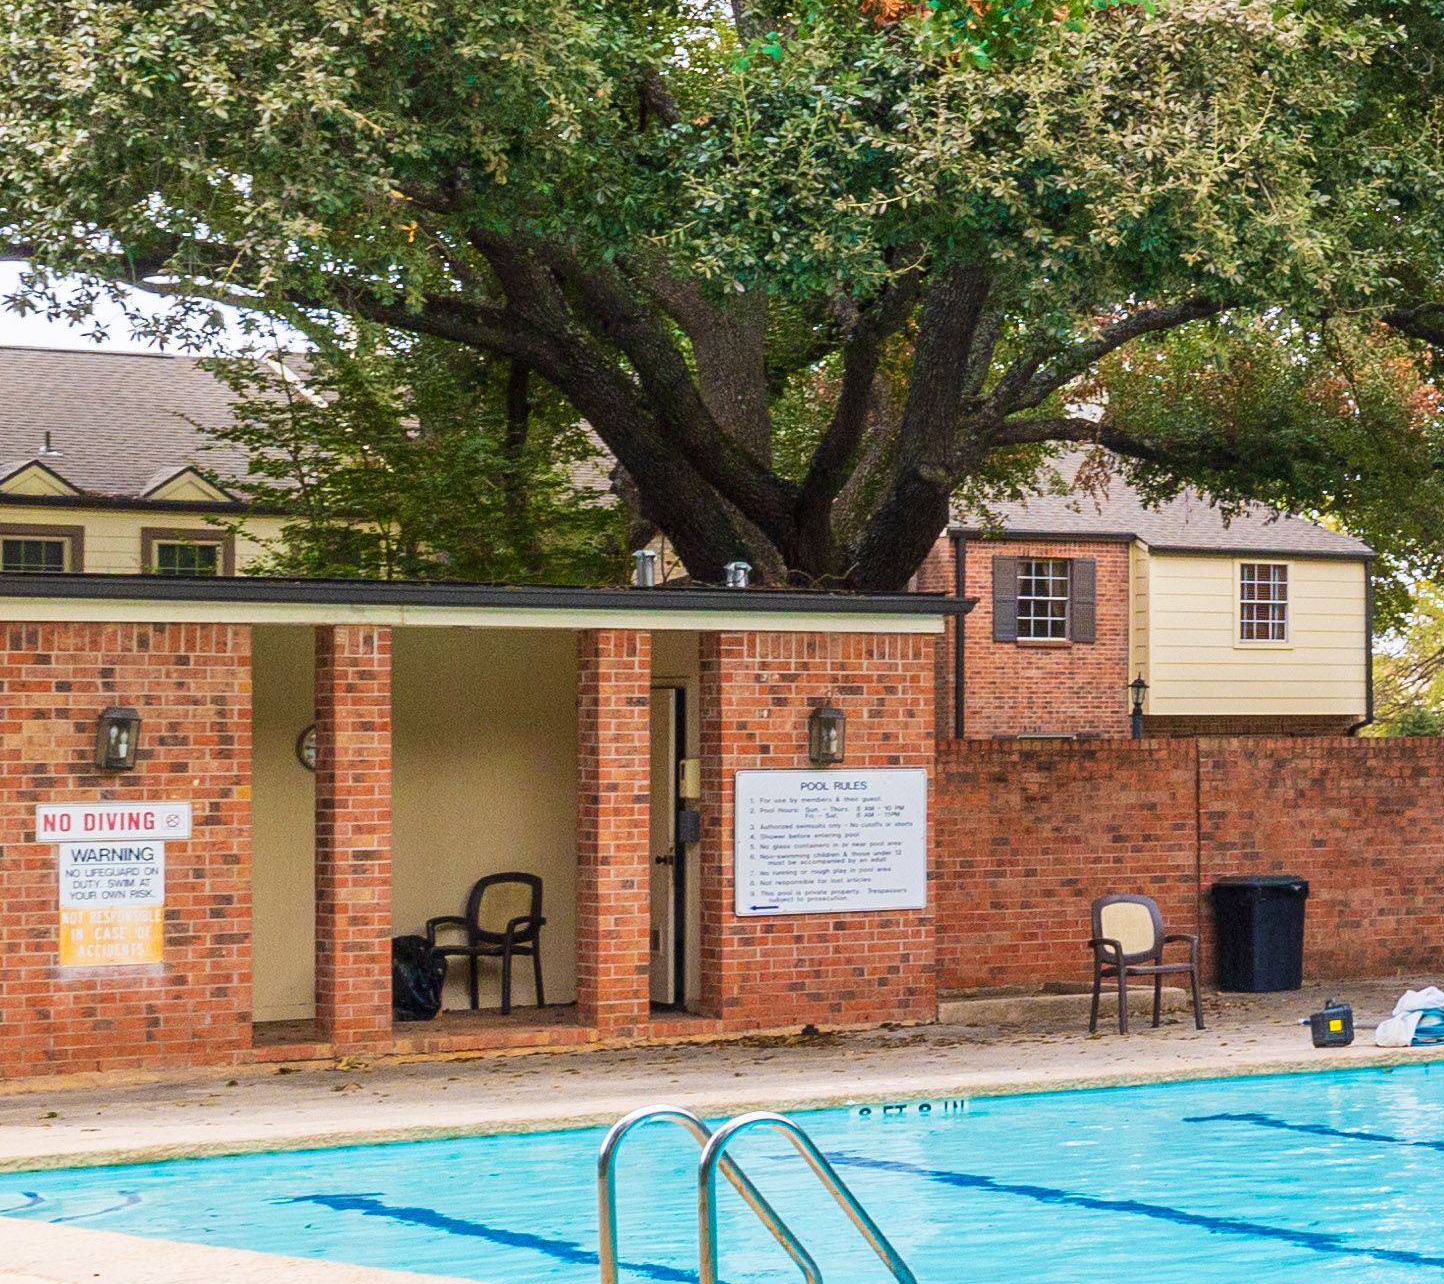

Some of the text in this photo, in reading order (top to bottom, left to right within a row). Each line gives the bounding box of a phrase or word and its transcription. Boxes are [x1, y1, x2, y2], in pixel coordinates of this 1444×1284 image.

[800, 781, 868, 791] POOL RULES
[44, 812, 155, 832] NO DIVING
[71, 847, 154, 862] WARNING
[66, 867, 159, 877] NO LIFEGUARD ON
[108, 879, 134, 888] SWIM
[69, 892, 96, 900] YOUR
[102, 891, 126, 899] OWN
[96, 927, 126, 940] CASE
[78, 943, 145, 957] ACCIDENTS
